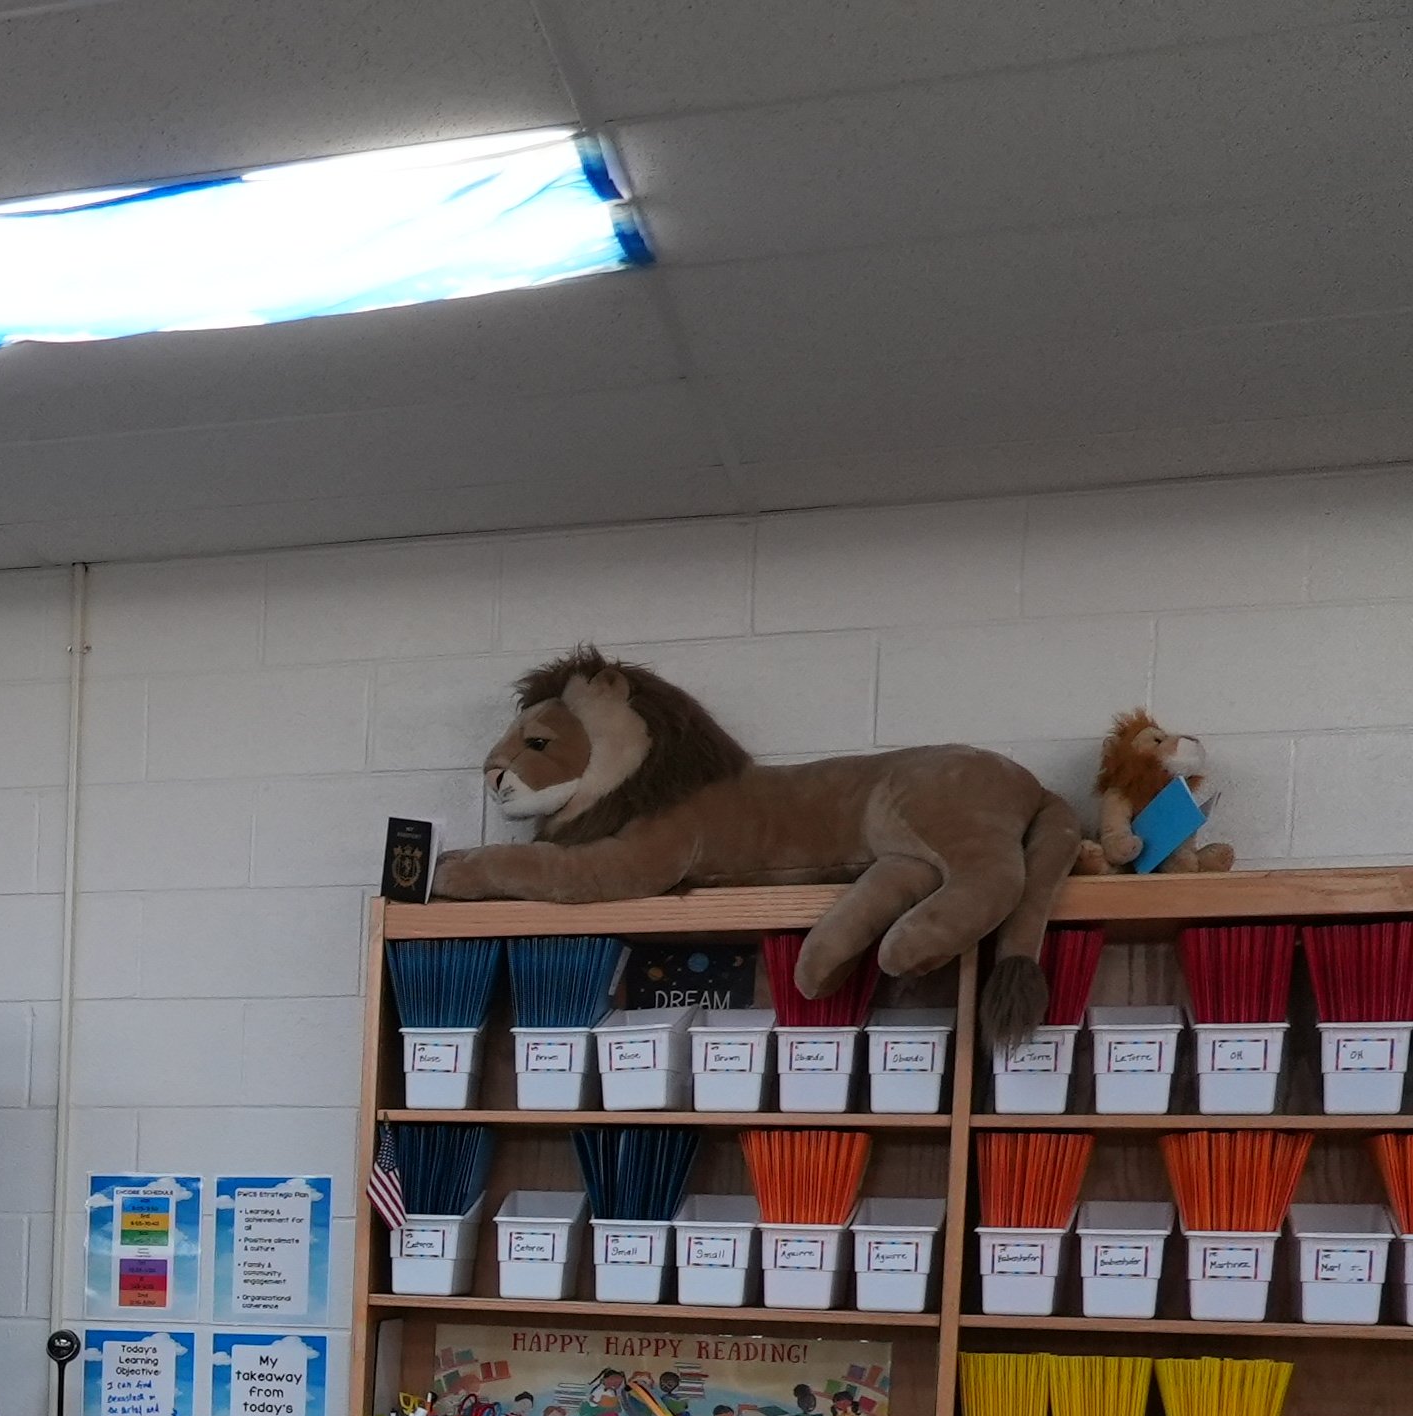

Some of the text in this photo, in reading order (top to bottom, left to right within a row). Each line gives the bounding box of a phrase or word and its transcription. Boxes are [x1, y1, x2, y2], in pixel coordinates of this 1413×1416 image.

[655, 990, 730, 1009] DREAM
[714, 1054, 740, 1062] Brown
[121, 1345, 157, 1354] Today's
[513, 1332, 808, 1364] HAPPY, HAPPY READING!
[119, 1356, 158, 1366] Learning
[260, 1356, 278, 1368] My
[236, 1370, 302, 1385] takeaway
[249, 1386, 284, 1397] from
[243, 1402, 293, 1415] today's
